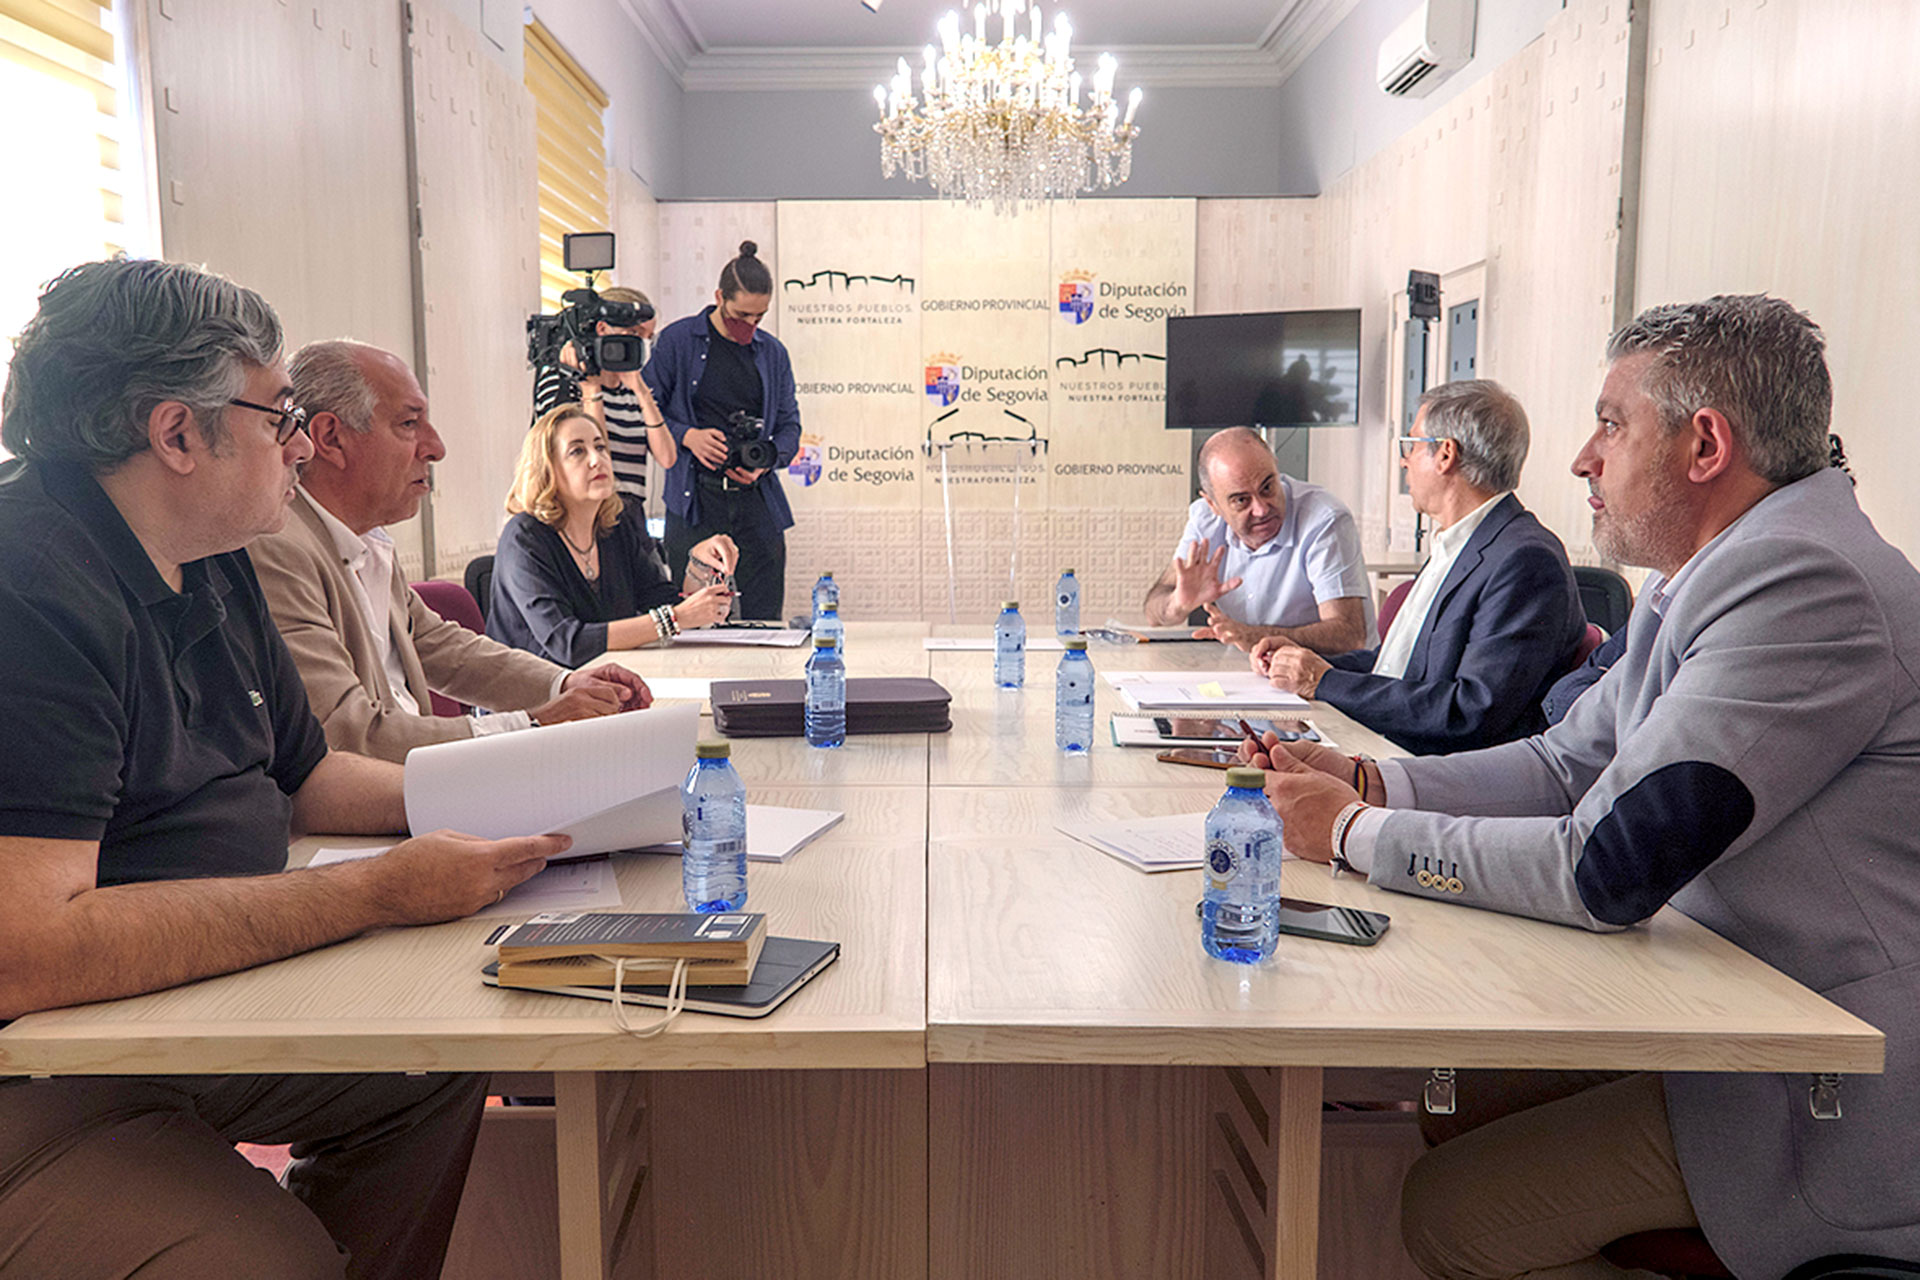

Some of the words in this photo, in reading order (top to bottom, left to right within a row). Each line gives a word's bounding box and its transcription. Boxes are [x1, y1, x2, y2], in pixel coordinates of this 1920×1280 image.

[1099, 281, 1187, 299] Diputación
[788, 303, 853, 313] NUESTROS
[857, 303, 912, 313] PUEBLOS
[920, 299, 981, 311] GOBIERNO
[982, 299, 1051, 311] PROVINCIAL
[1098, 304, 1119, 319] de
[1124, 303, 1187, 322] Segovia
[961, 365, 1048, 384] Diputación
[795, 383, 844, 394] OBIERNO
[847, 383, 915, 394] PROVINCIAL
[1060, 382, 1124, 391] NUESTROS
[1129, 382, 1166, 391] PUEBL
[961, 387, 982, 402] de
[986, 386, 1049, 406] Segovia
[1068, 394, 1114, 402] NUESTRA
[1118, 394, 1166, 402] FORTALEZ
[828, 446, 914, 464] Diputación
[1054, 463, 1114, 475] GOBIERNO
[1117, 463, 1184, 475] PROVINCIAL
[828, 468, 849, 482] de
[853, 467, 915, 486] Segovia
[935, 476, 979, 484] NESTRA
